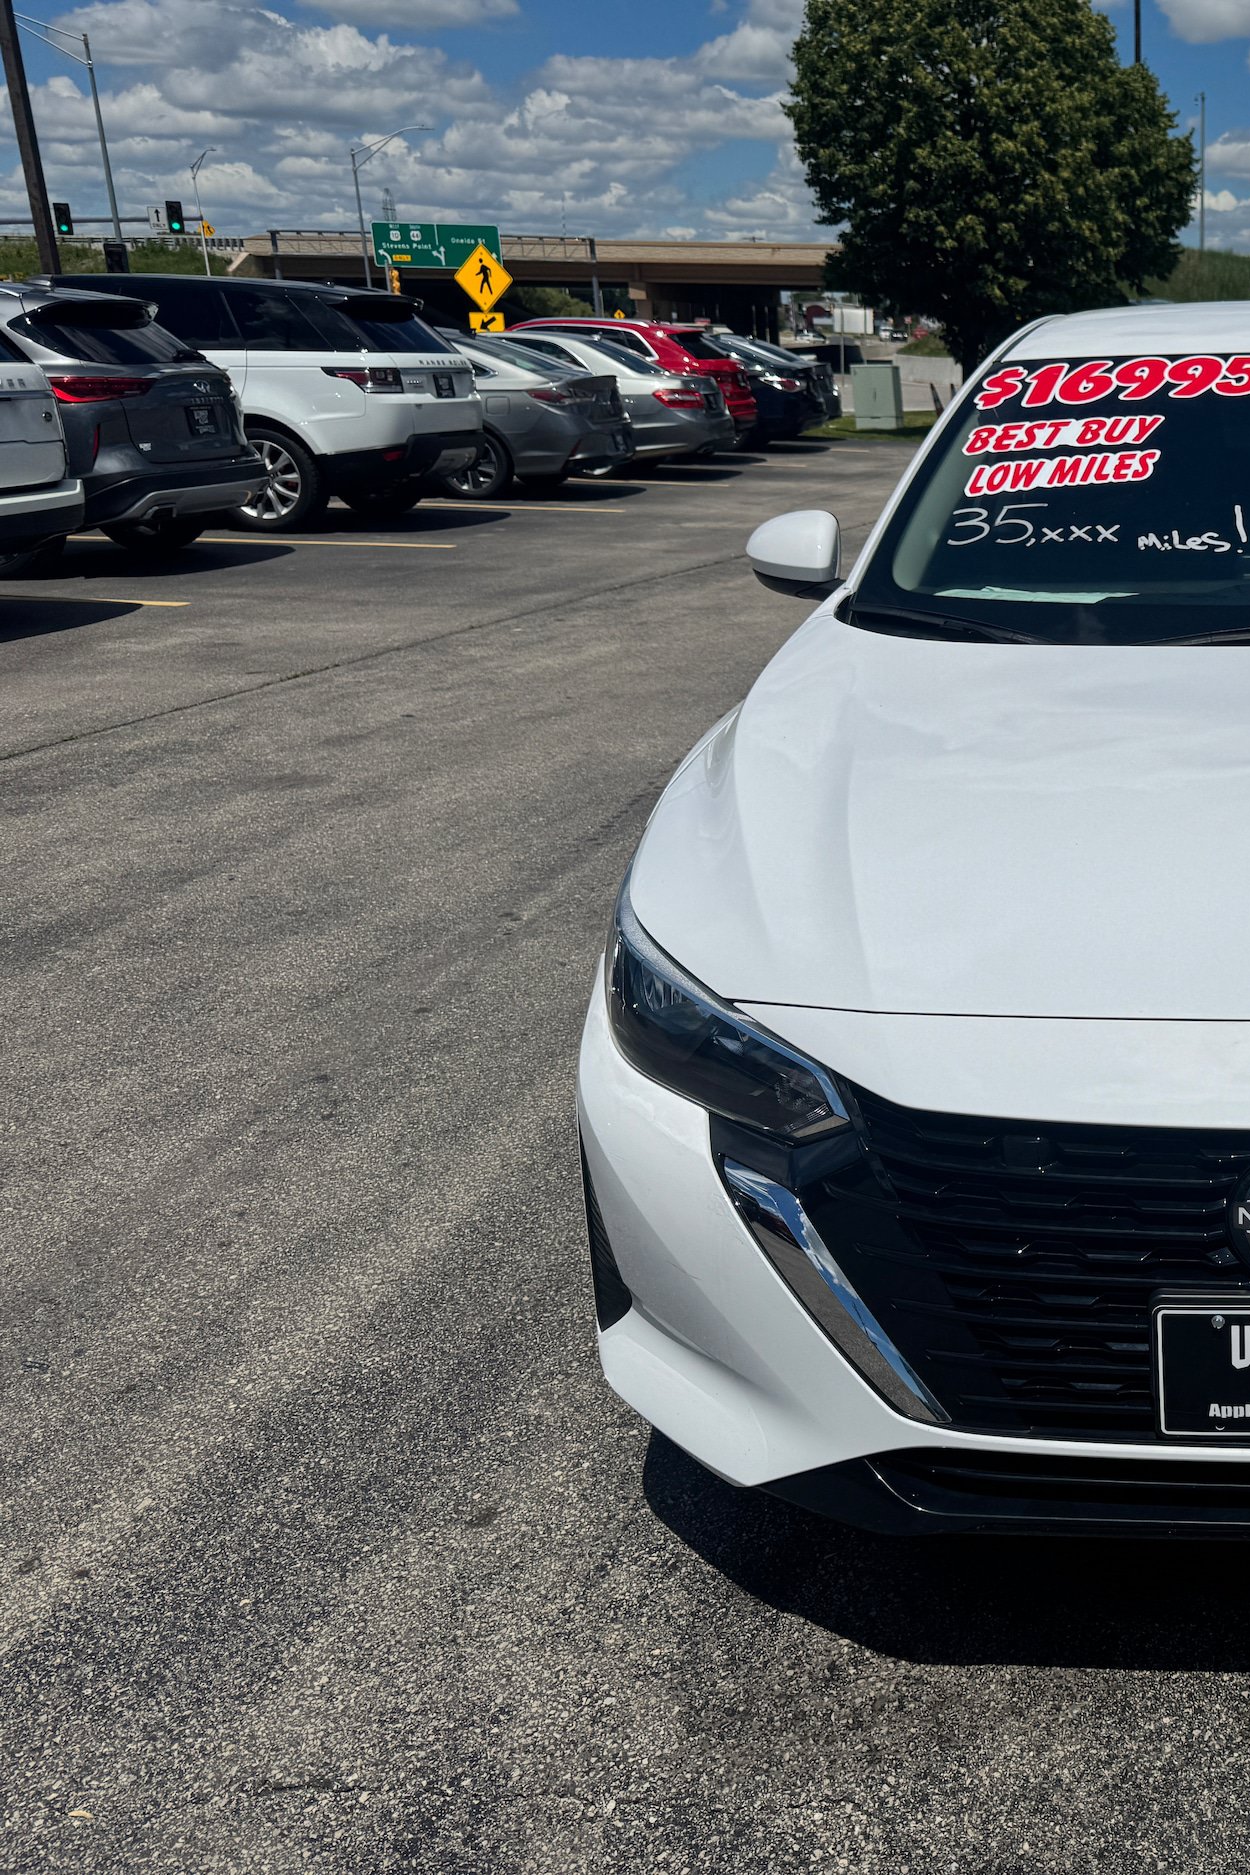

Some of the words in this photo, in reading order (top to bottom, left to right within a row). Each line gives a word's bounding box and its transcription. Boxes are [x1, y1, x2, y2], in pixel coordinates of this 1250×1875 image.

[963, 420, 1072, 456] BEST
[1075, 415, 1165, 445] BUY
[965, 460, 1047, 497] LOW
[1047, 450, 1160, 486] MILES
